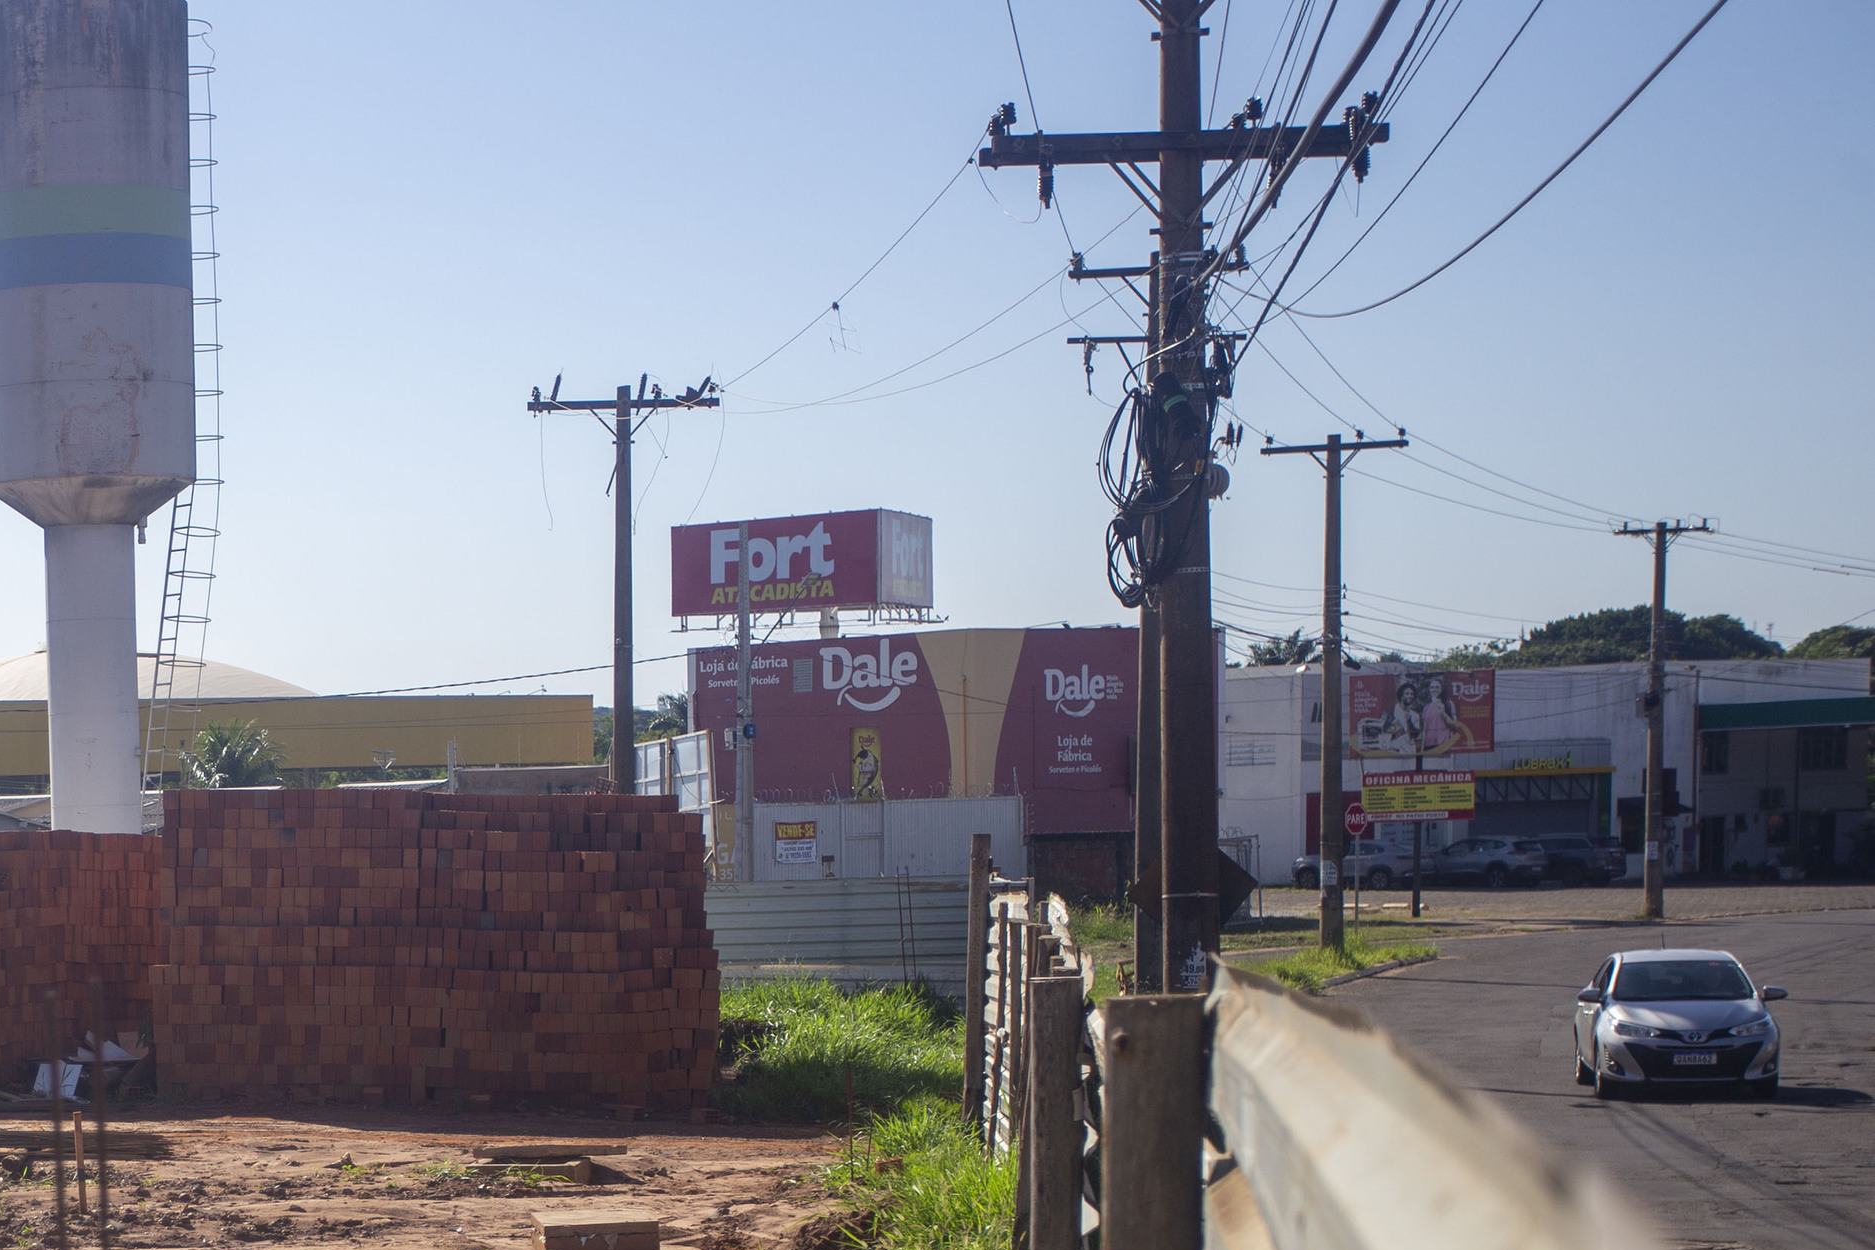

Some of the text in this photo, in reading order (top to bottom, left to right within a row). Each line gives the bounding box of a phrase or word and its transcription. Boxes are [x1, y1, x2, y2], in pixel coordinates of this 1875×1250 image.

[710, 521, 835, 585] Fort
[711, 579, 835, 604] ATCADISTA
[700, 660, 725, 676] Loja
[751, 656, 788, 670] ábrica
[819, 639, 918, 690] Dale
[708, 674, 780, 688] Sorvete Picolés
[1044, 664, 1105, 701] Dale
[1452, 680, 1490, 696] Dale
[1057, 734, 1093, 749] Loja de
[1057, 749, 1093, 762] Fábrica
[1049, 765, 1075, 774] Sorvetes
[1081, 764, 1102, 773] Picolés
[1365, 772, 1472, 786] OFICINA MECÂNICA
[1346, 813, 1365, 825] PARE
[777, 823, 815, 838] VENDE-SE
